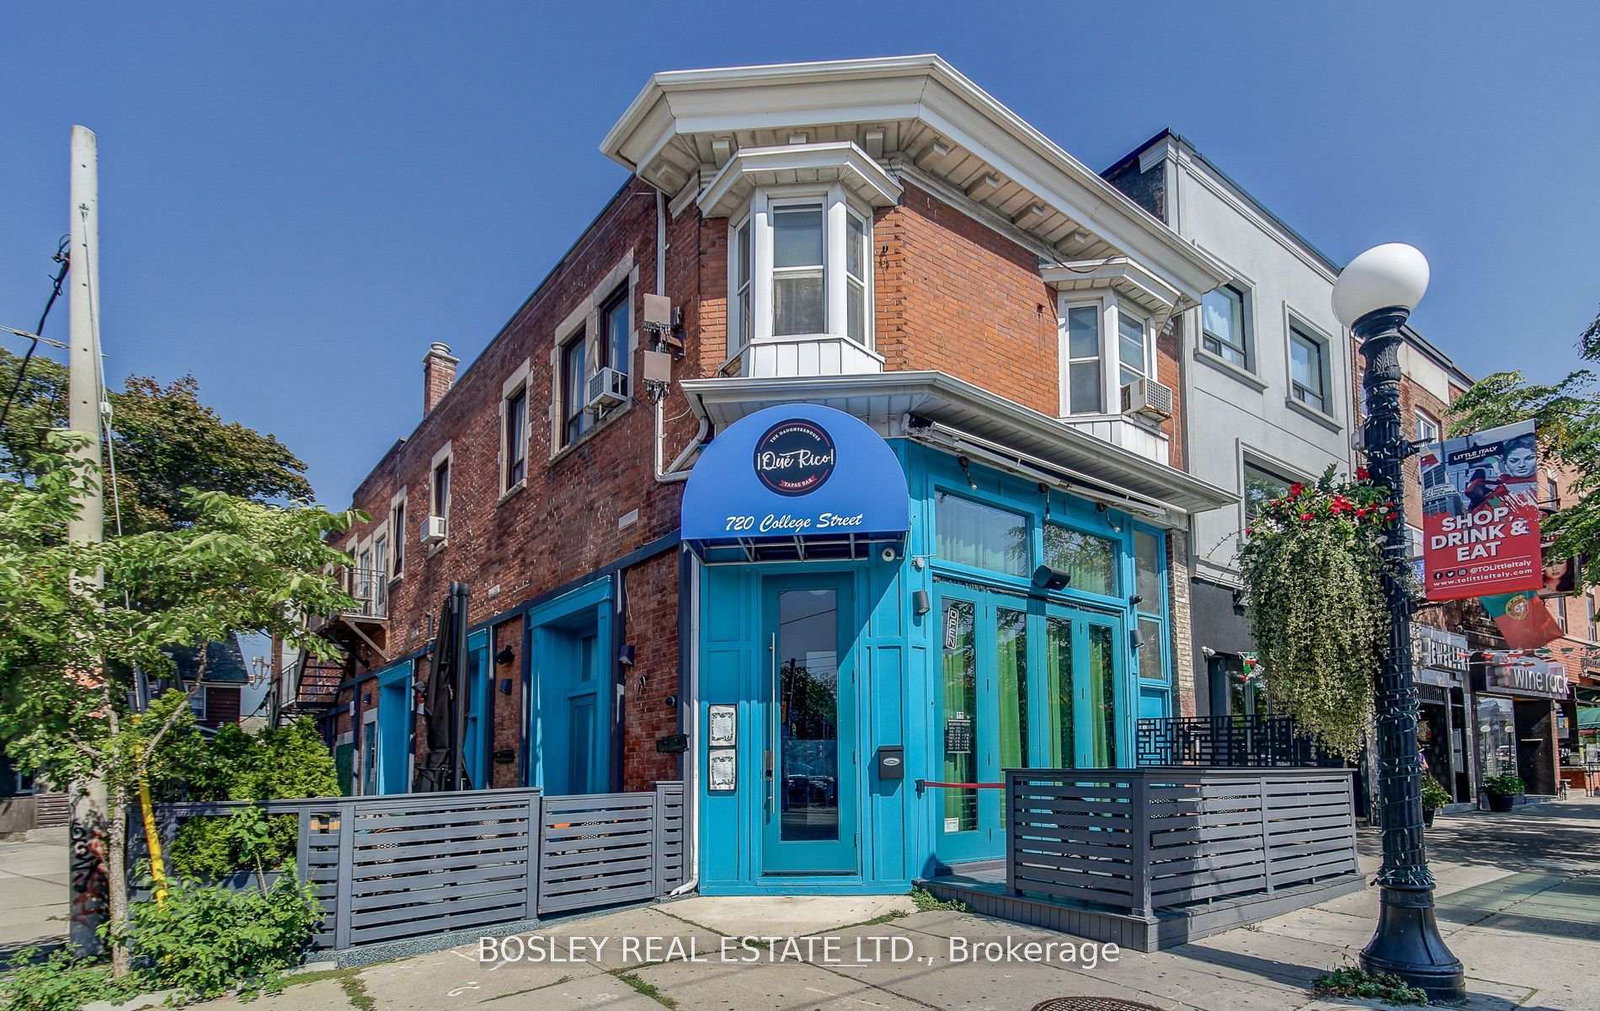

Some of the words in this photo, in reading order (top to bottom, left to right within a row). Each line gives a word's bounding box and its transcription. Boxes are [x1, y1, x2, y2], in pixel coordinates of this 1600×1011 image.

[1453, 450, 1477, 461] LITTLE
[1478, 445, 1498, 455] ITALY
[802, 478, 813, 486] BAR
[725, 515, 755, 531] 720
[759, 513, 812, 533] College
[816, 512, 863, 528] Street
[1441, 506, 1514, 532] SHOP,
[1431, 523, 1506, 550] DRINK
[1510, 519, 1530, 536] &
[1457, 540, 1502, 562] EAT
[948, 609, 957, 647] OPEN
